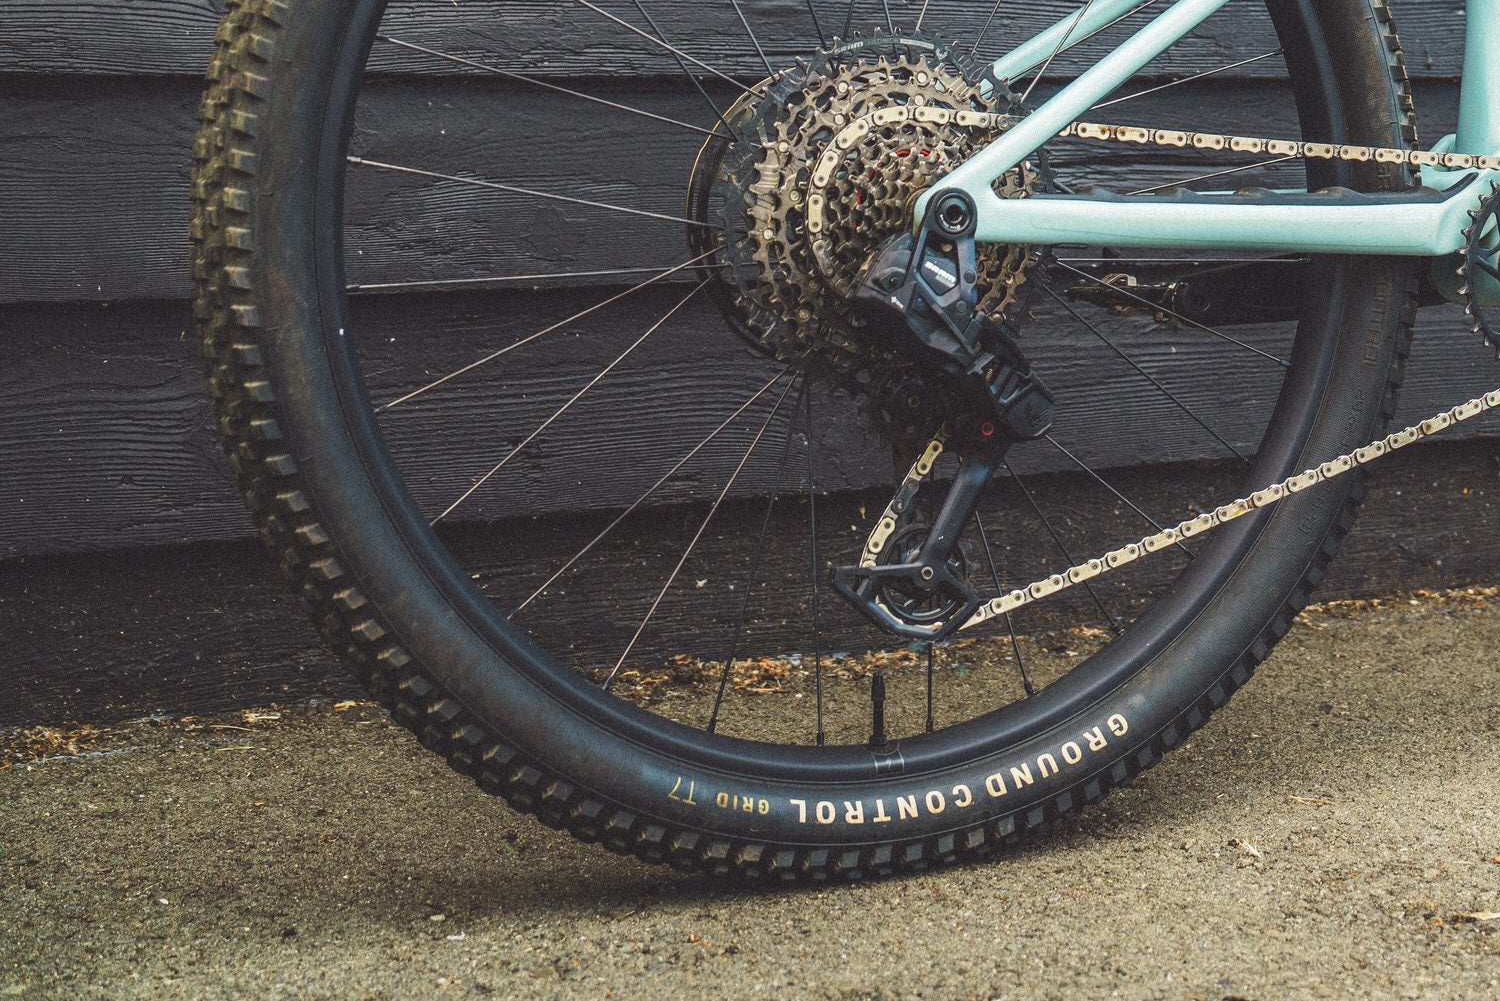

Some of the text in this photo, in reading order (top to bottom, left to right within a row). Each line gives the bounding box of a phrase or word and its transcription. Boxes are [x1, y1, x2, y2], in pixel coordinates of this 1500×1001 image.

[667, 712, 1130, 826] GROUND CONTROL GRID T7
